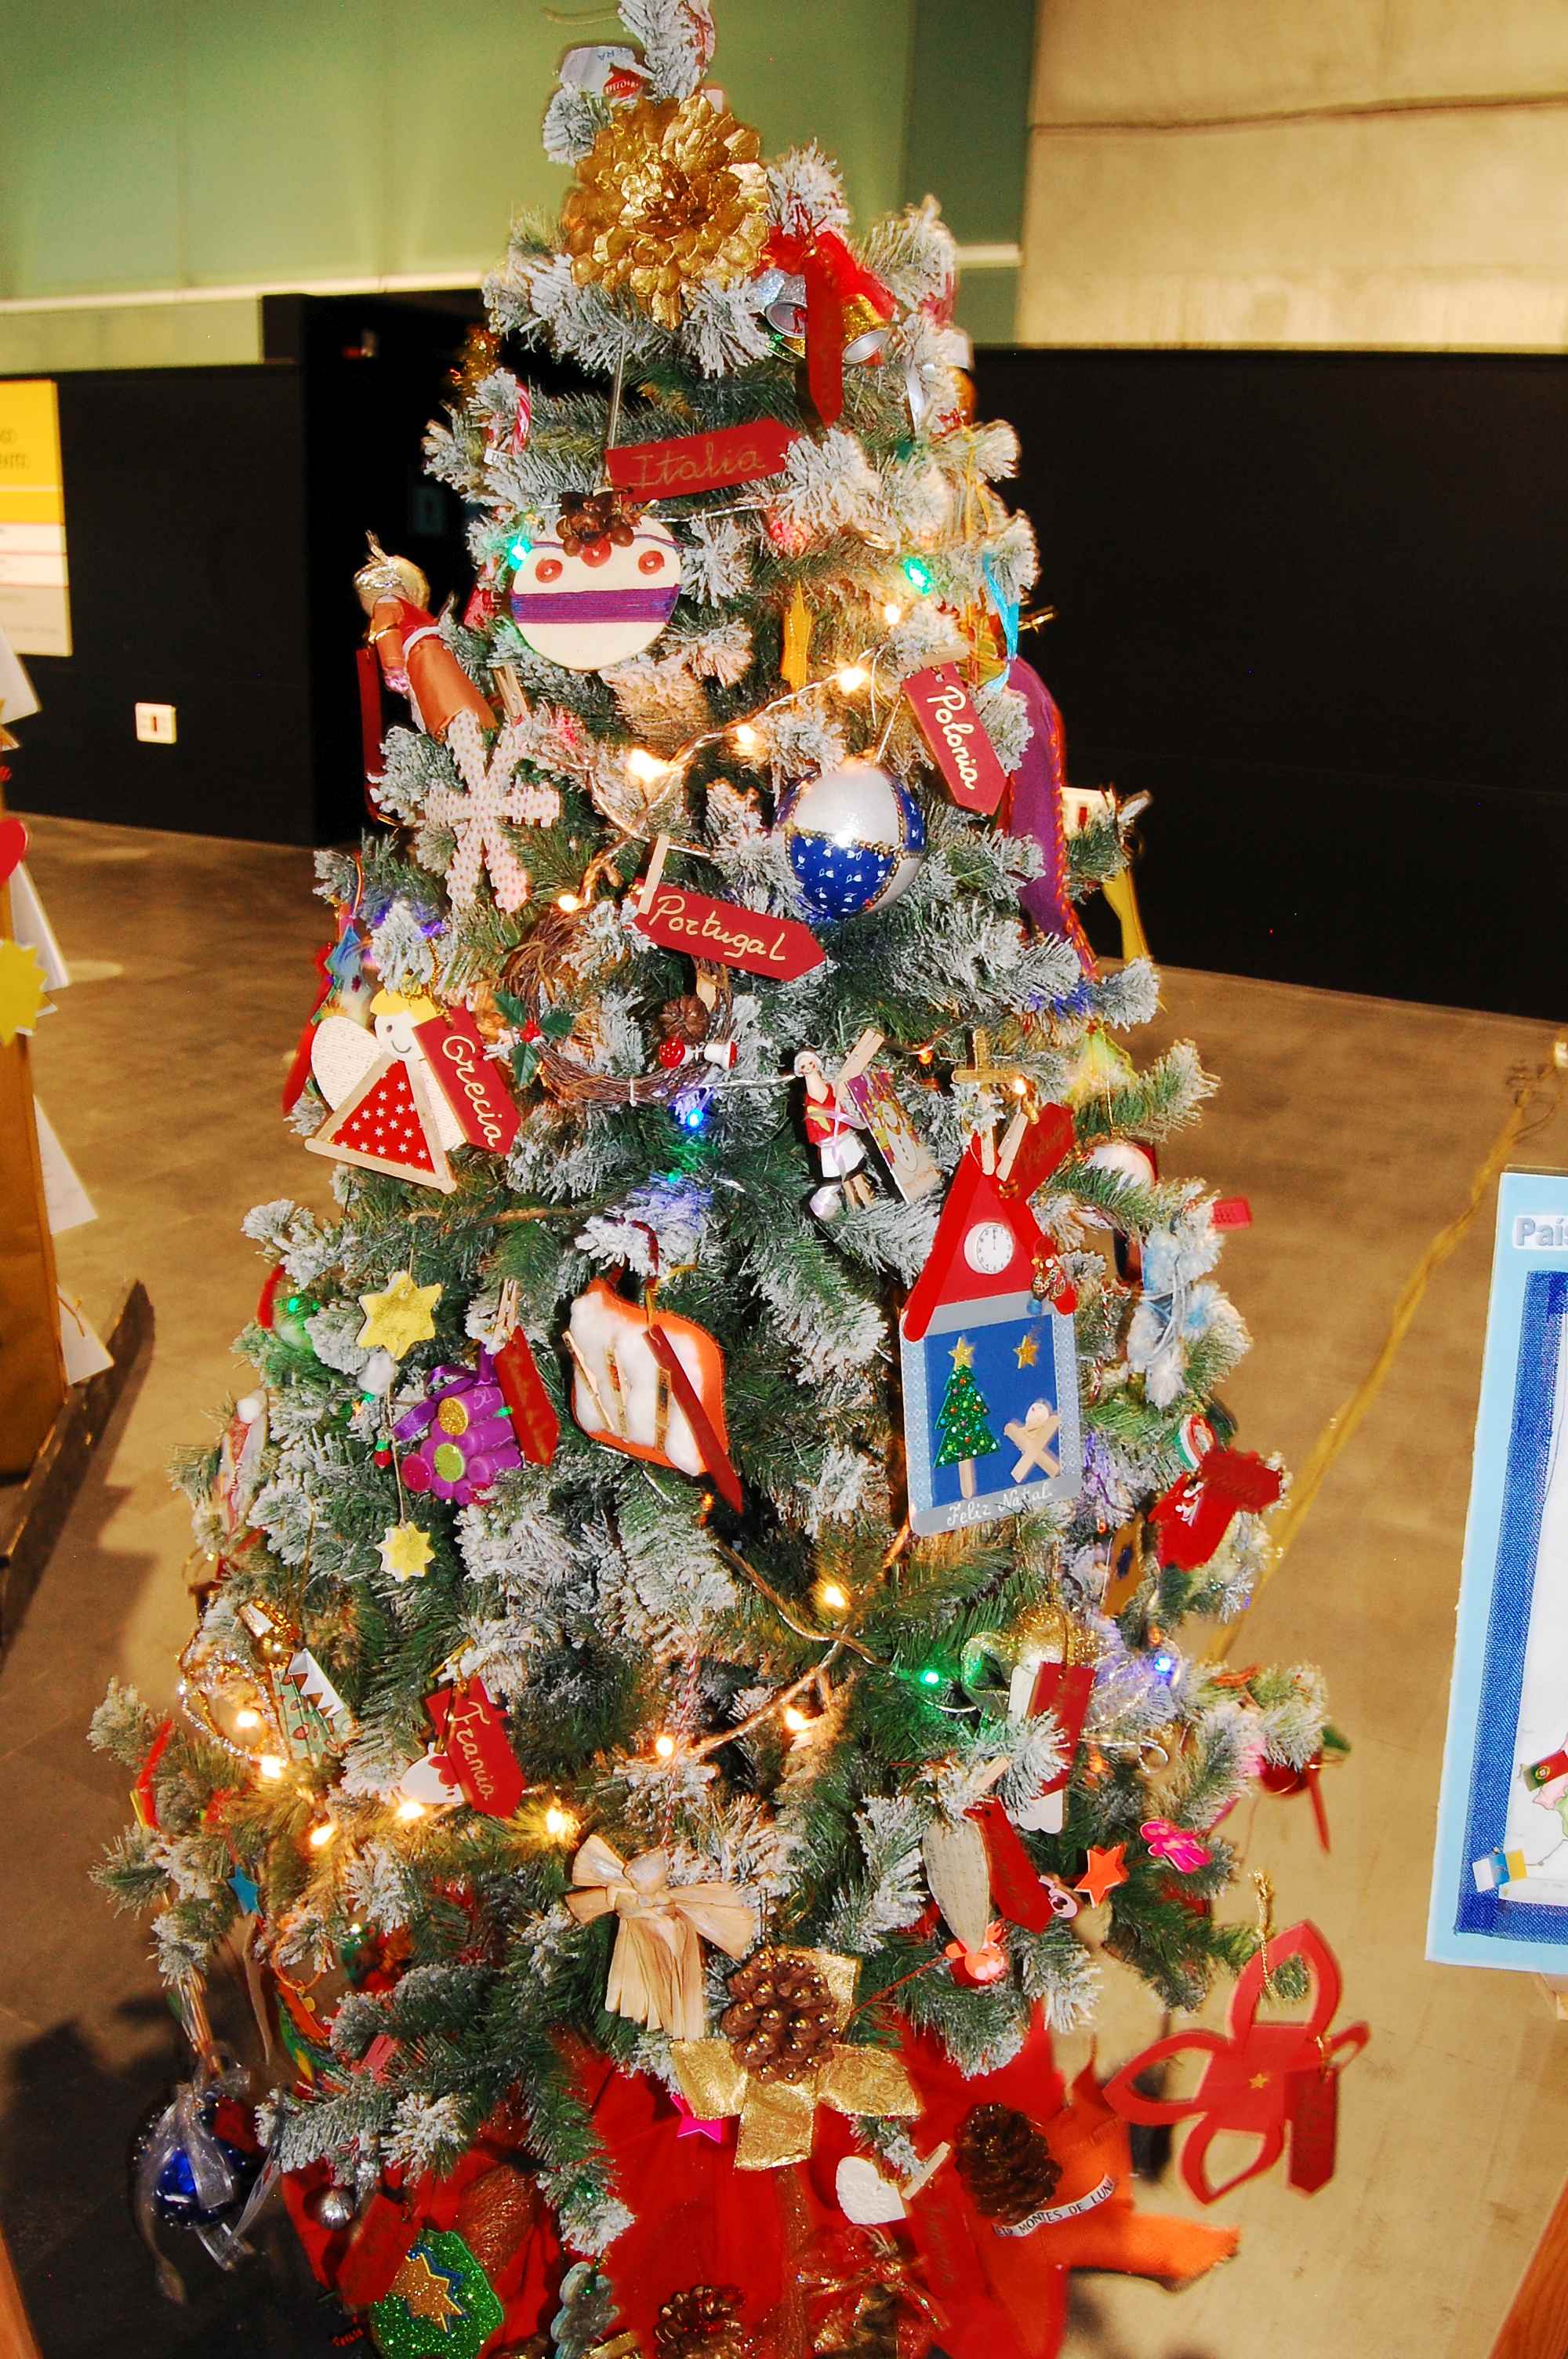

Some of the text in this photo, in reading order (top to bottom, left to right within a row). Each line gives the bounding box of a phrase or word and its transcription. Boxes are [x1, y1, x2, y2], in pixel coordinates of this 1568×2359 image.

[628, 442, 765, 489] Italia
[927, 685, 978, 791] Polonia
[648, 895, 786, 961] Portugal
[441, 1035, 502, 1147] Grecia
[947, 1481, 1053, 1526] Feliz Natal
[449, 1701, 495, 1801] Francia
[1019, 2211, 1063, 2234] MONTES
[1069, 2202, 1086, 2215] DE
